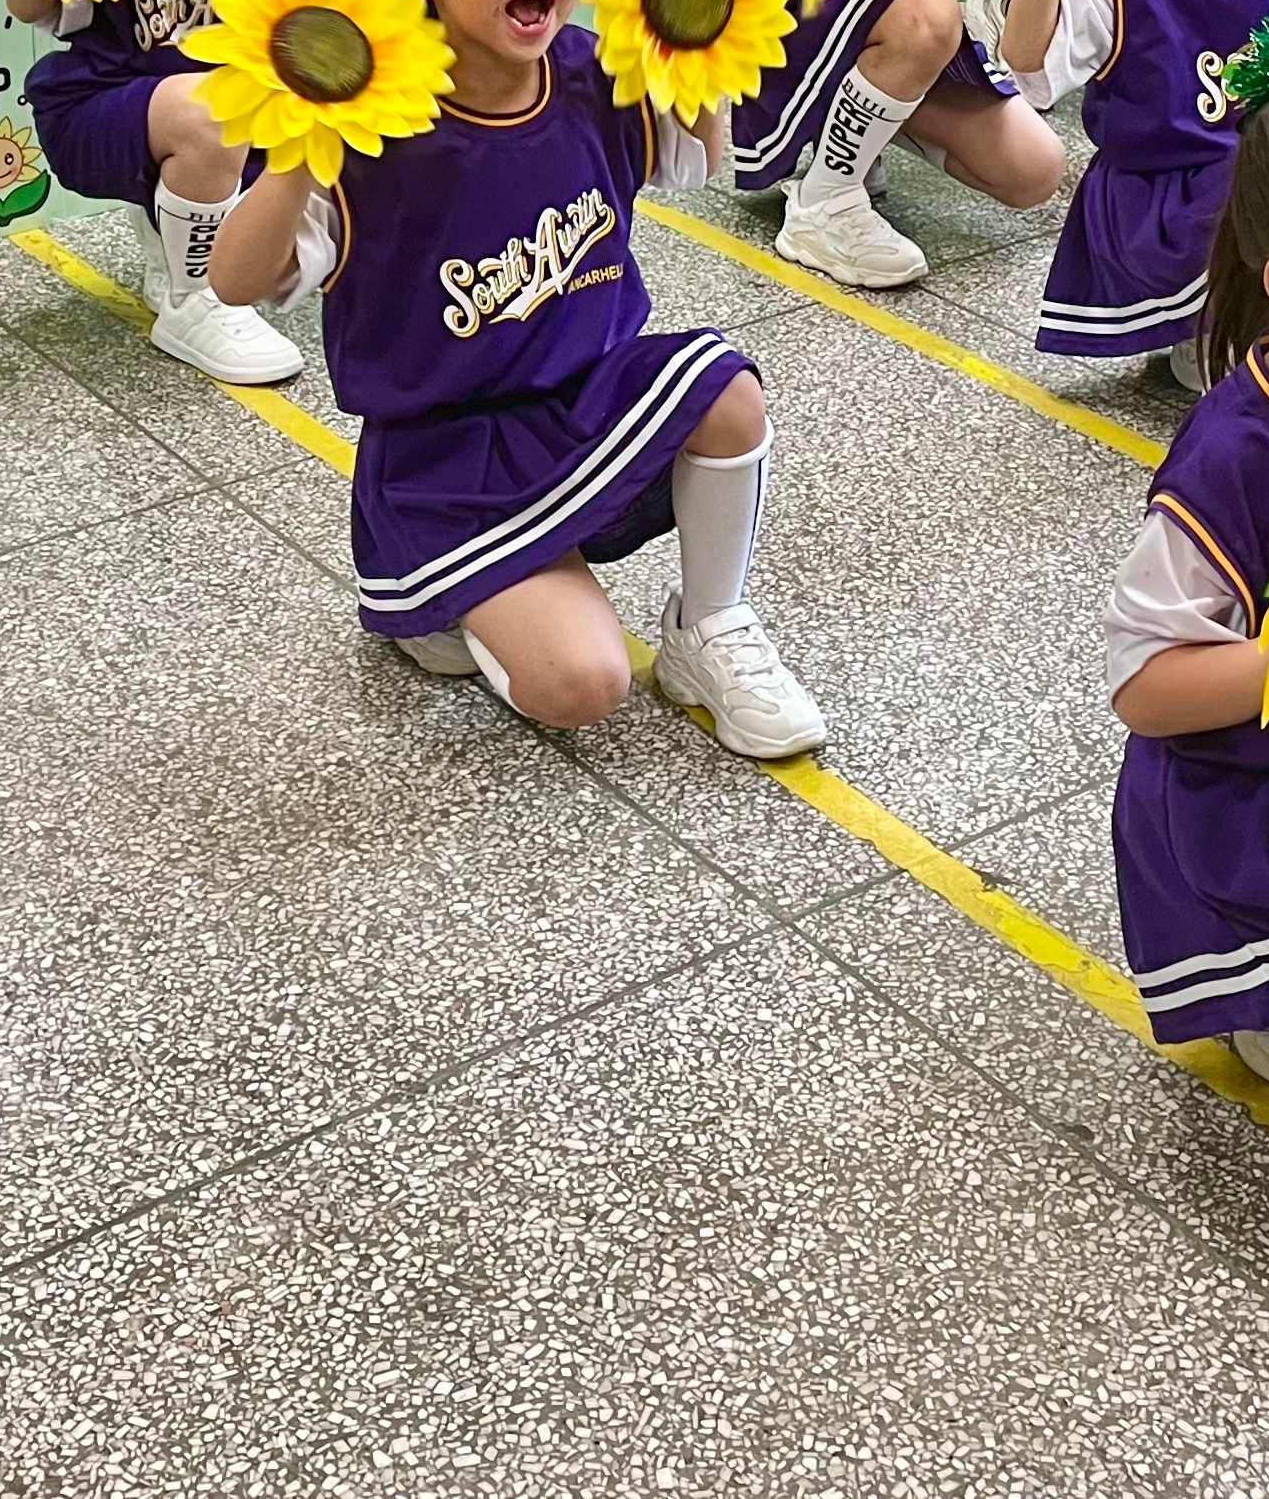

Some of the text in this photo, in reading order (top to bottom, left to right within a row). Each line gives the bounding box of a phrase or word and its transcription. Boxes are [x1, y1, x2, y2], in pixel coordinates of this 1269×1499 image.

[824, 97, 874, 177] SUPER
[439, 187, 616, 339] South Austin
